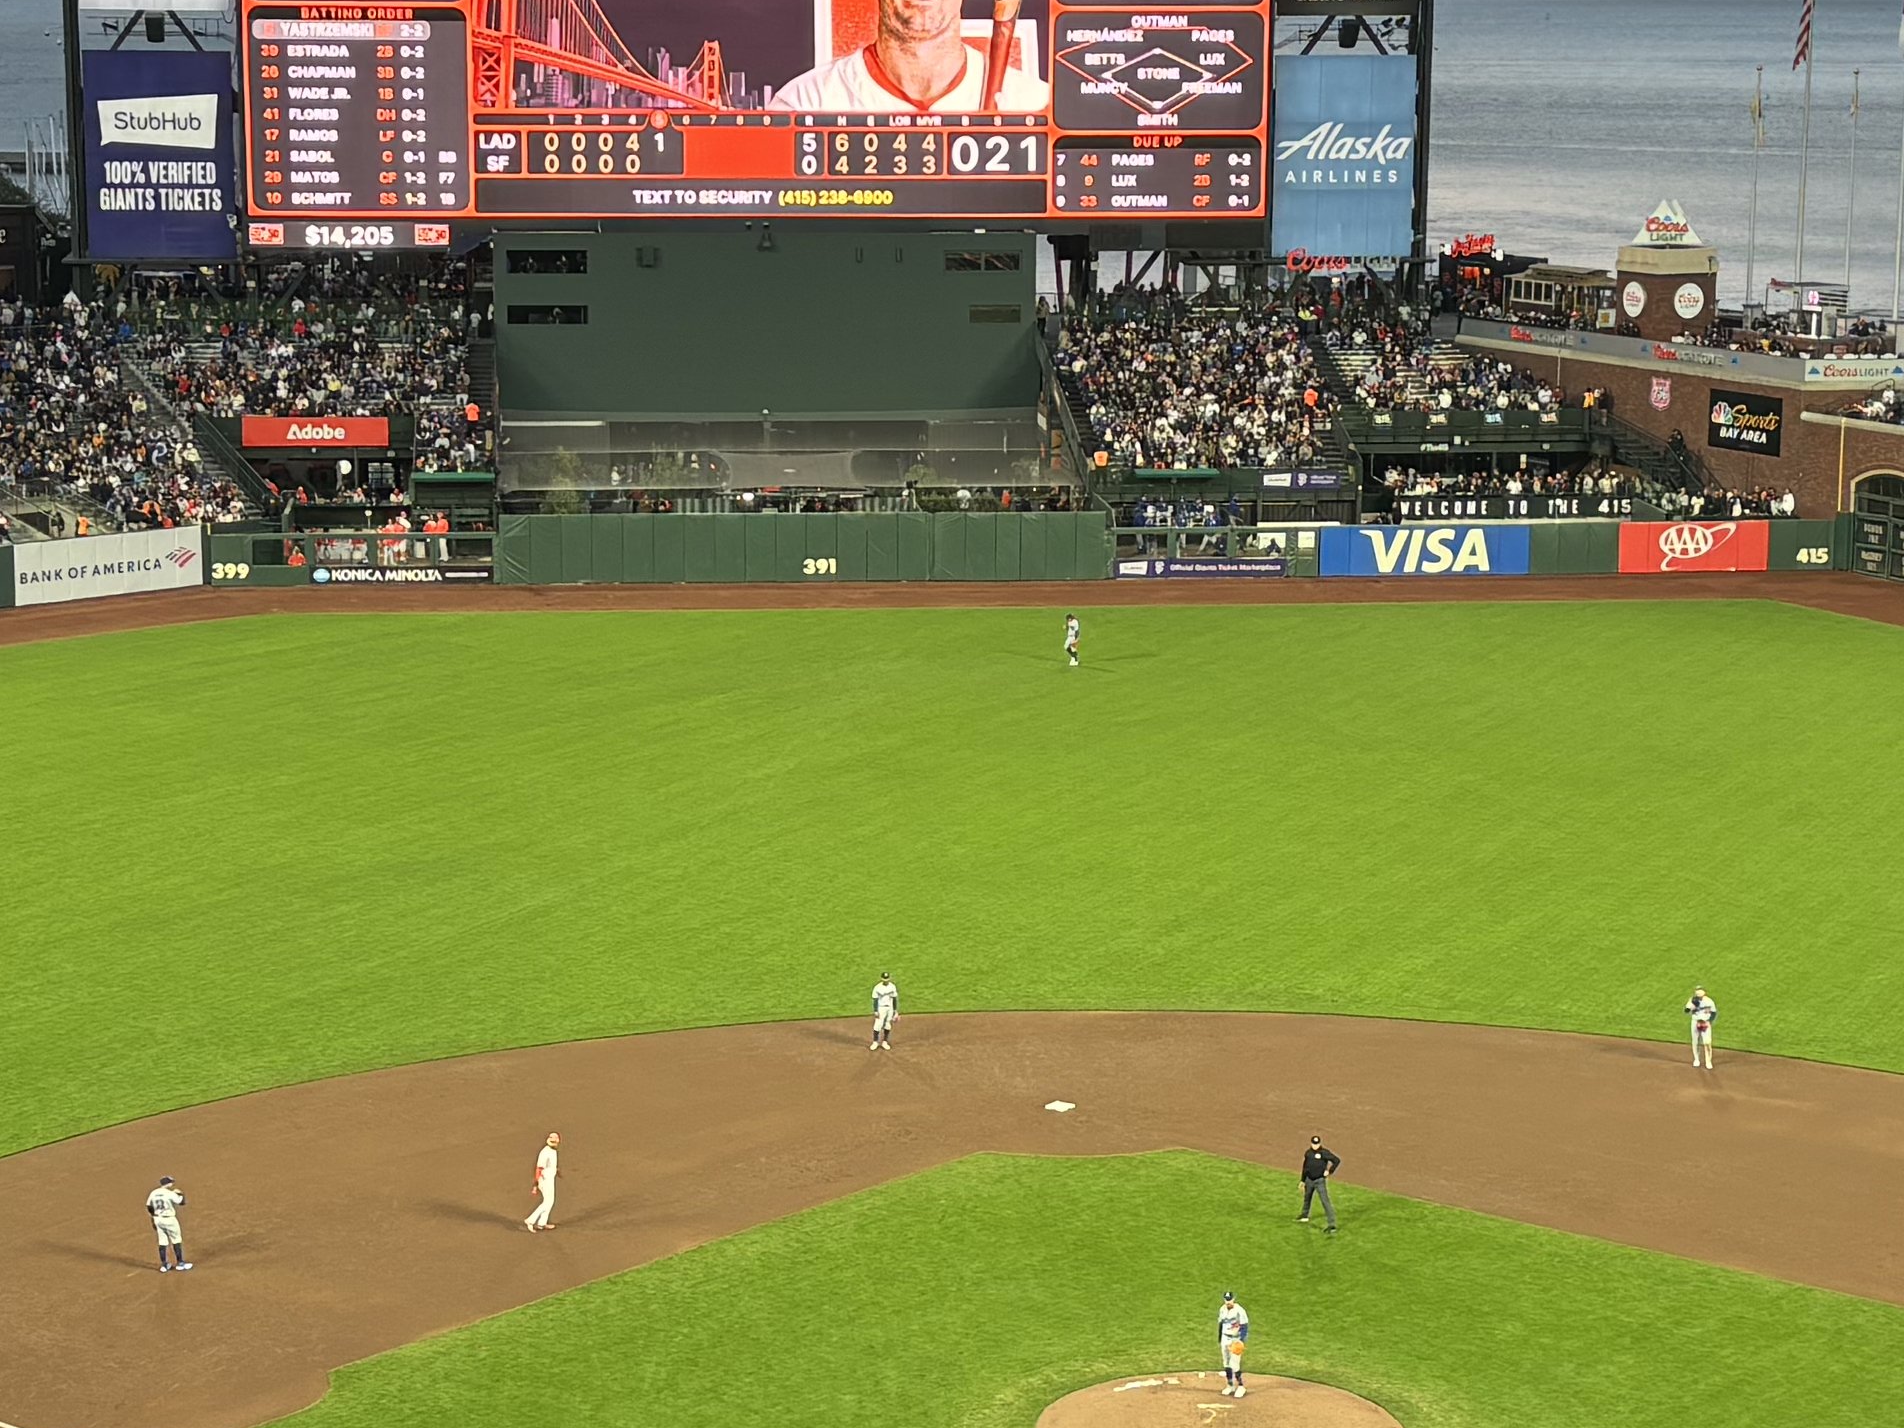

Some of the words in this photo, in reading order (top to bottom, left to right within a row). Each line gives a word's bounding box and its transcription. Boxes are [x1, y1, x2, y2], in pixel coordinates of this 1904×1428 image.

[300, 6, 363, 19] BATTING
[367, 7, 414, 20] ORDER
[1131, 15, 1188, 28] OUTMAN
[1066, 27, 1144, 42] HERNÁNDEZ
[1191, 30, 1235, 42] PAGES
[287, 45, 350, 58] ESTRADA
[287, 66, 356, 79] CHAPMAN
[287, 87, 330, 100] WADE
[113, 111, 202, 131] StubHub
[288, 108, 339, 121] FLORES
[289, 129, 339, 142] RAMOS
[478, 133, 516, 150] LAD
[1276, 121, 1413, 165] Alaska
[486, 155, 510, 172] SF
[103, 160, 146, 185] 100%
[147, 161, 217, 185] VERIFIED
[1285, 169, 1399, 183] AIRLINES
[99, 187, 156, 211] GIANTS
[158, 188, 223, 211] TICKETS
[291, 192, 352, 205] SCHMITT
[633, 189, 673, 204] TEXT
[675, 189, 696, 204] TO
[699, 189, 773, 204] SECURITY
[778, 190, 817, 207] (415)
[1646, 216, 1689, 233] Coors
[305, 224, 394, 248] $14,205
[1650, 233, 1685, 242] LIGHT
[1823, 365, 1859, 379] Coors
[1859, 367, 1891, 378] LIGHT
[1733, 404, 1780, 432] Sports
[286, 423, 346, 441] Adobe
[1719, 427, 1739, 442] BAY
[1739, 430, 1767, 444] AREA
[1400, 500, 1489, 516] WELCOME
[1508, 500, 1528, 515] TO
[1548, 498, 1579, 515] THE
[1597, 499, 1632, 514] 415
[1663, 528, 1709, 551] AAA
[1360, 528, 1491, 574] VISA
[1796, 547, 1829, 565] 415
[19, 567, 63, 585] BANK
[68, 564, 89, 578] OF
[92, 558, 162, 576] AMERICA
[211, 562, 250, 580] 399
[332, 568, 382, 582] KONICA
[384, 567, 443, 582] MINOLTA
[802, 557, 837, 576] 391
